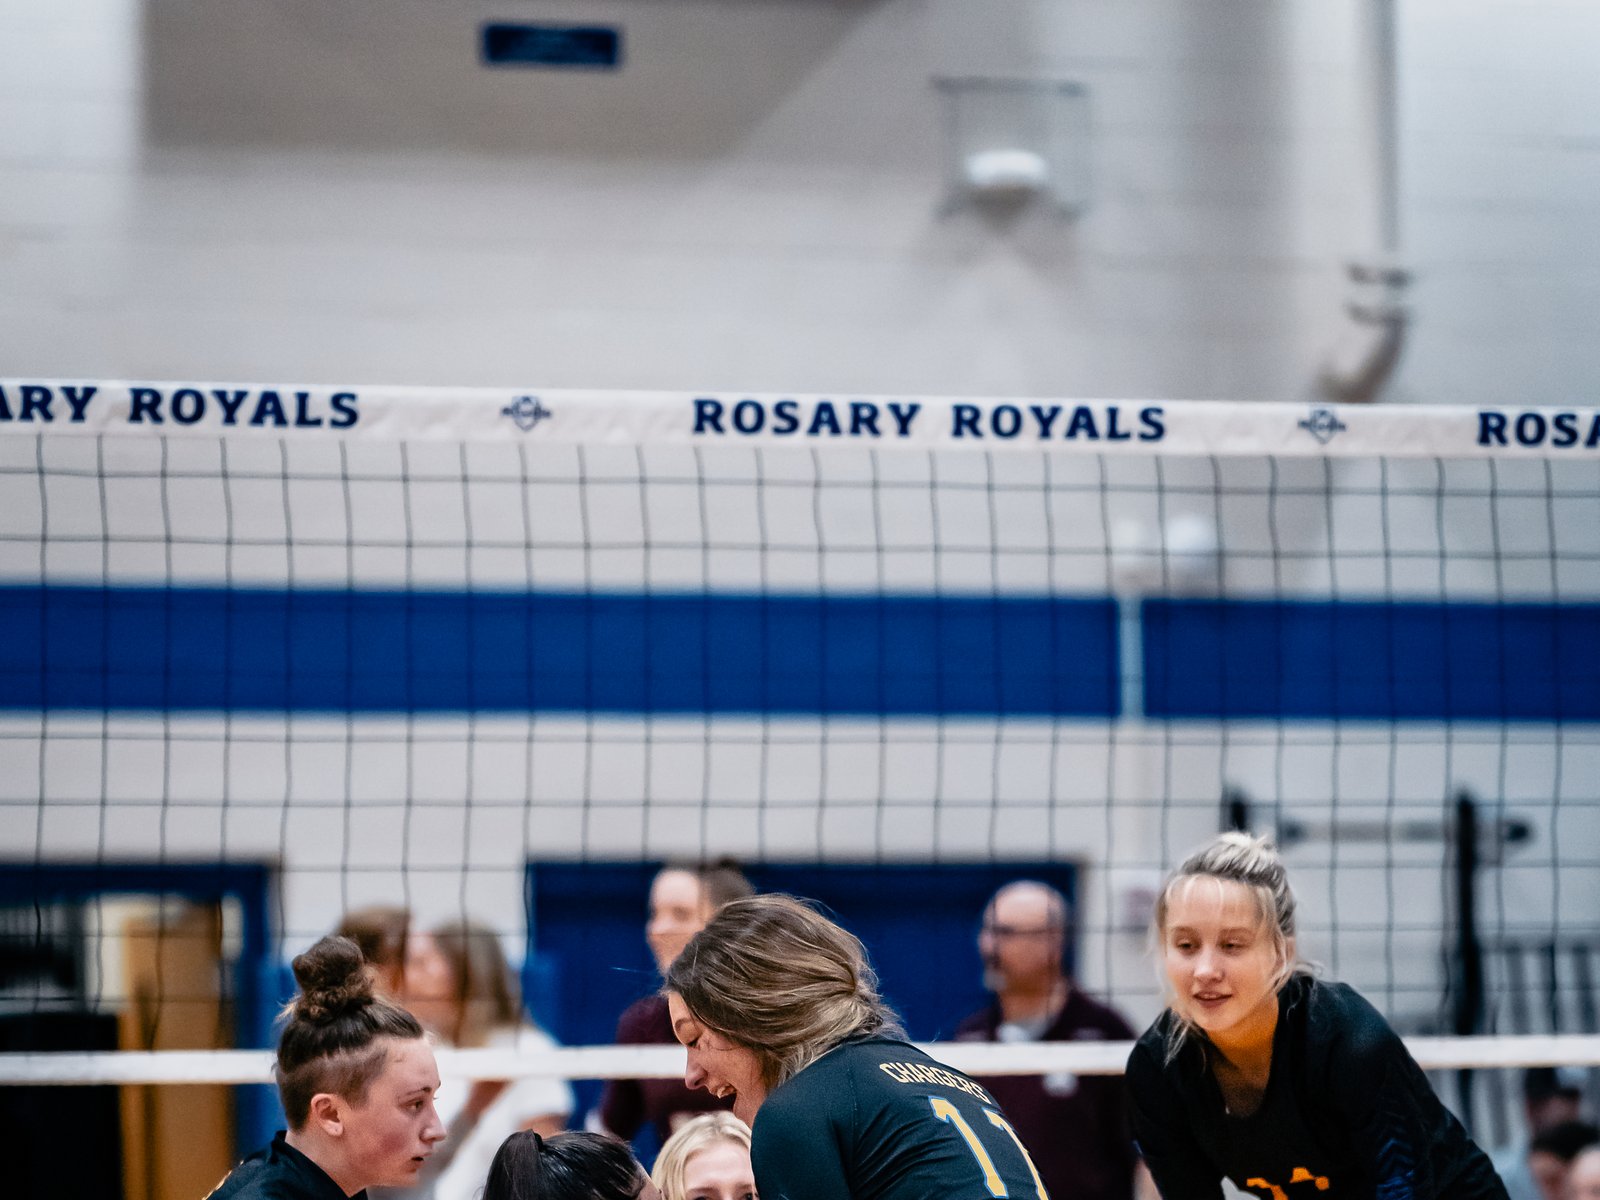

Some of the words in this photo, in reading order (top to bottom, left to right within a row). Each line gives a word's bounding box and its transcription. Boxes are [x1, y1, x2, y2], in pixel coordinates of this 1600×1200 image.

[127, 387, 359, 429] ROYALS
[693, 399, 921, 438] ROSARY
[951, 404, 1166, 442] ROYALS
[879, 1062, 992, 1105] CHARGERS
